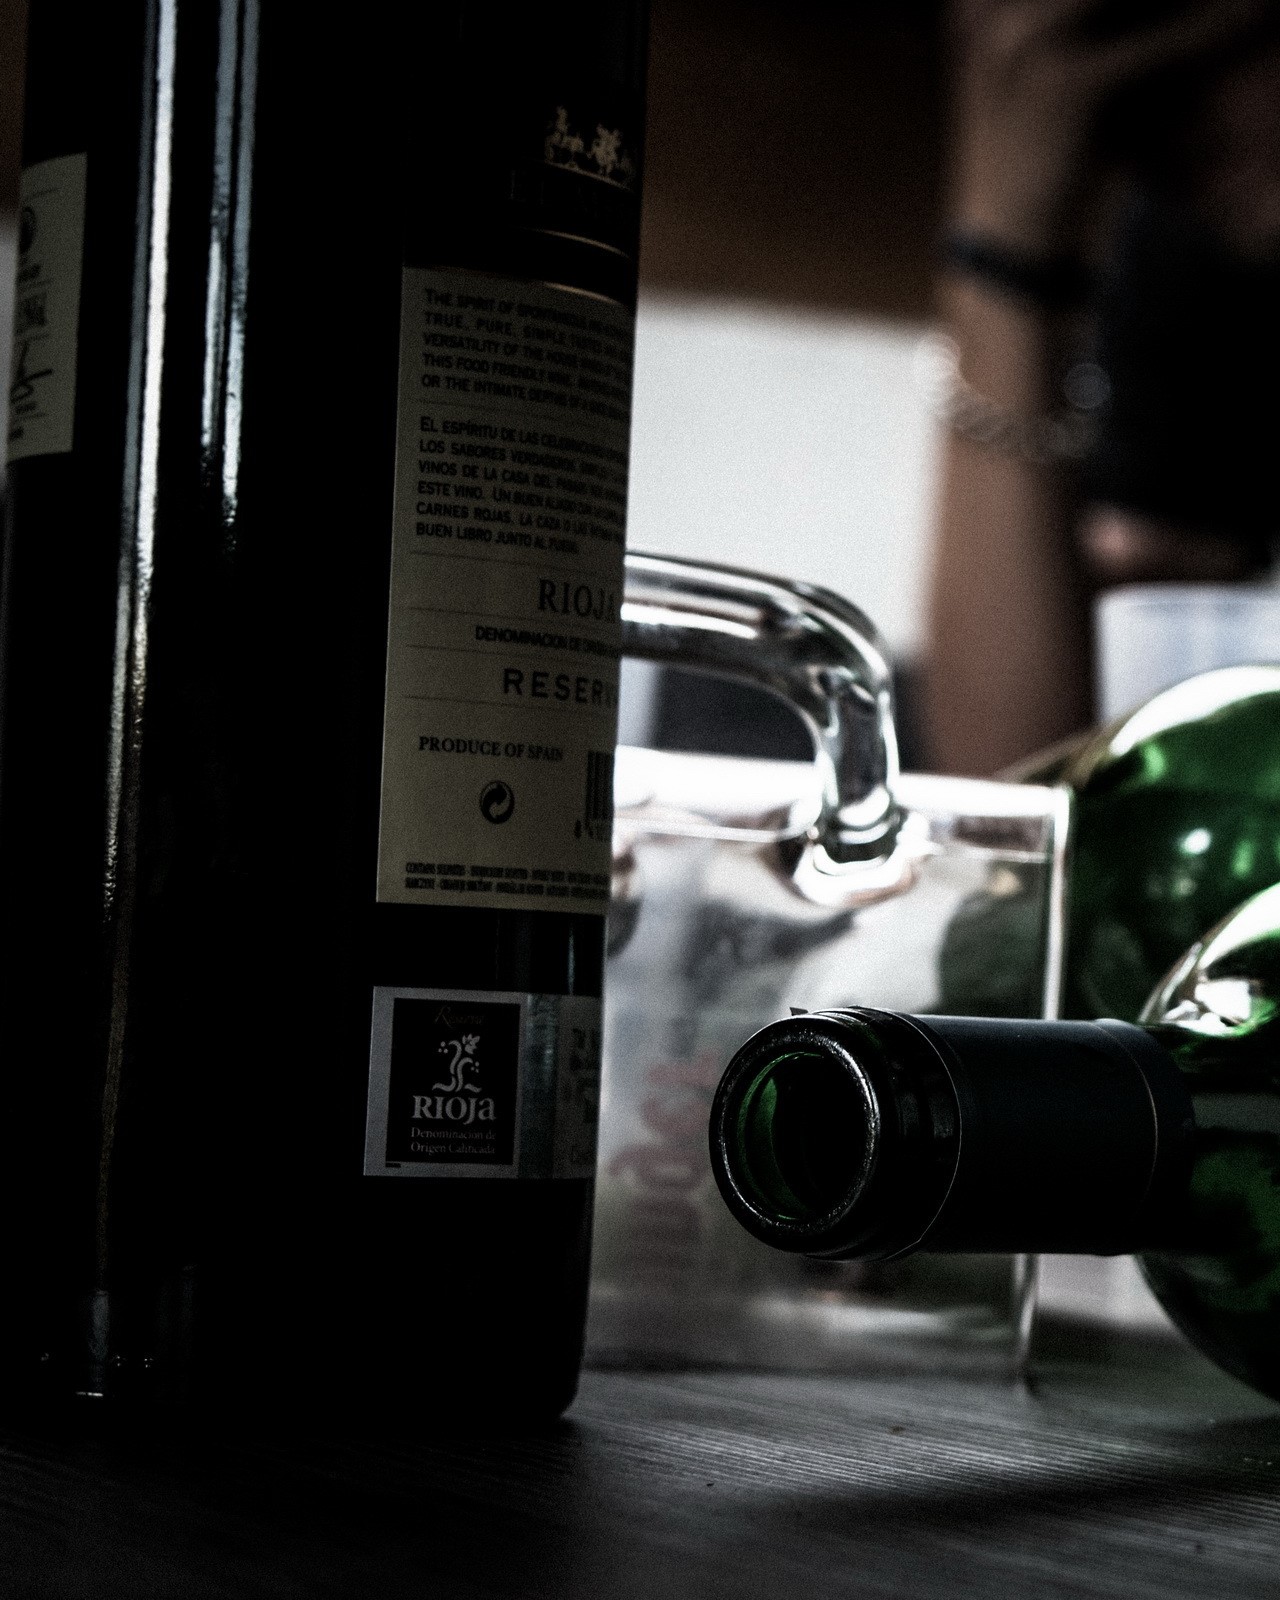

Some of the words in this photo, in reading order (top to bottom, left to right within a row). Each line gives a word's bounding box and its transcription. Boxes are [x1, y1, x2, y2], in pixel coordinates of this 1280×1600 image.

[425, 288, 452, 307] THE
[423, 332, 500, 354] VERSATILITY
[503, 342, 518, 356] OF
[423, 353, 453, 369] THIS
[457, 357, 489, 373] FOOD
[421, 374, 440, 388] OR
[445, 376, 470, 392] THE
[474, 380, 526, 400] INTIMATE
[420, 416, 437, 432] EL
[442, 419, 498, 439] ESPÍRITU
[501, 426, 516, 442] DE
[519, 430, 540, 446] LAS
[419, 439, 445, 453] LOS
[451, 442, 506, 461] SABORES
[419, 460, 457, 476] VINOS
[462, 464, 479, 479] DE
[484, 467, 497, 480] LA
[502, 469, 529, 484] CASA
[417, 481, 450, 496] ESTE
[493, 487, 511, 502] UN
[416, 502, 469, 519] CARNES
[519, 513, 533, 527] LA
[416, 522, 453, 537] BUEN
[457, 526, 492, 543] LIBRO
[495, 530, 532, 548] JUNTO
[419, 735, 501, 756] PRODUCE
[504, 743, 523, 759] OF
[527, 746, 564, 762] SPAIN
[410, 1140, 447, 1156] Origen
